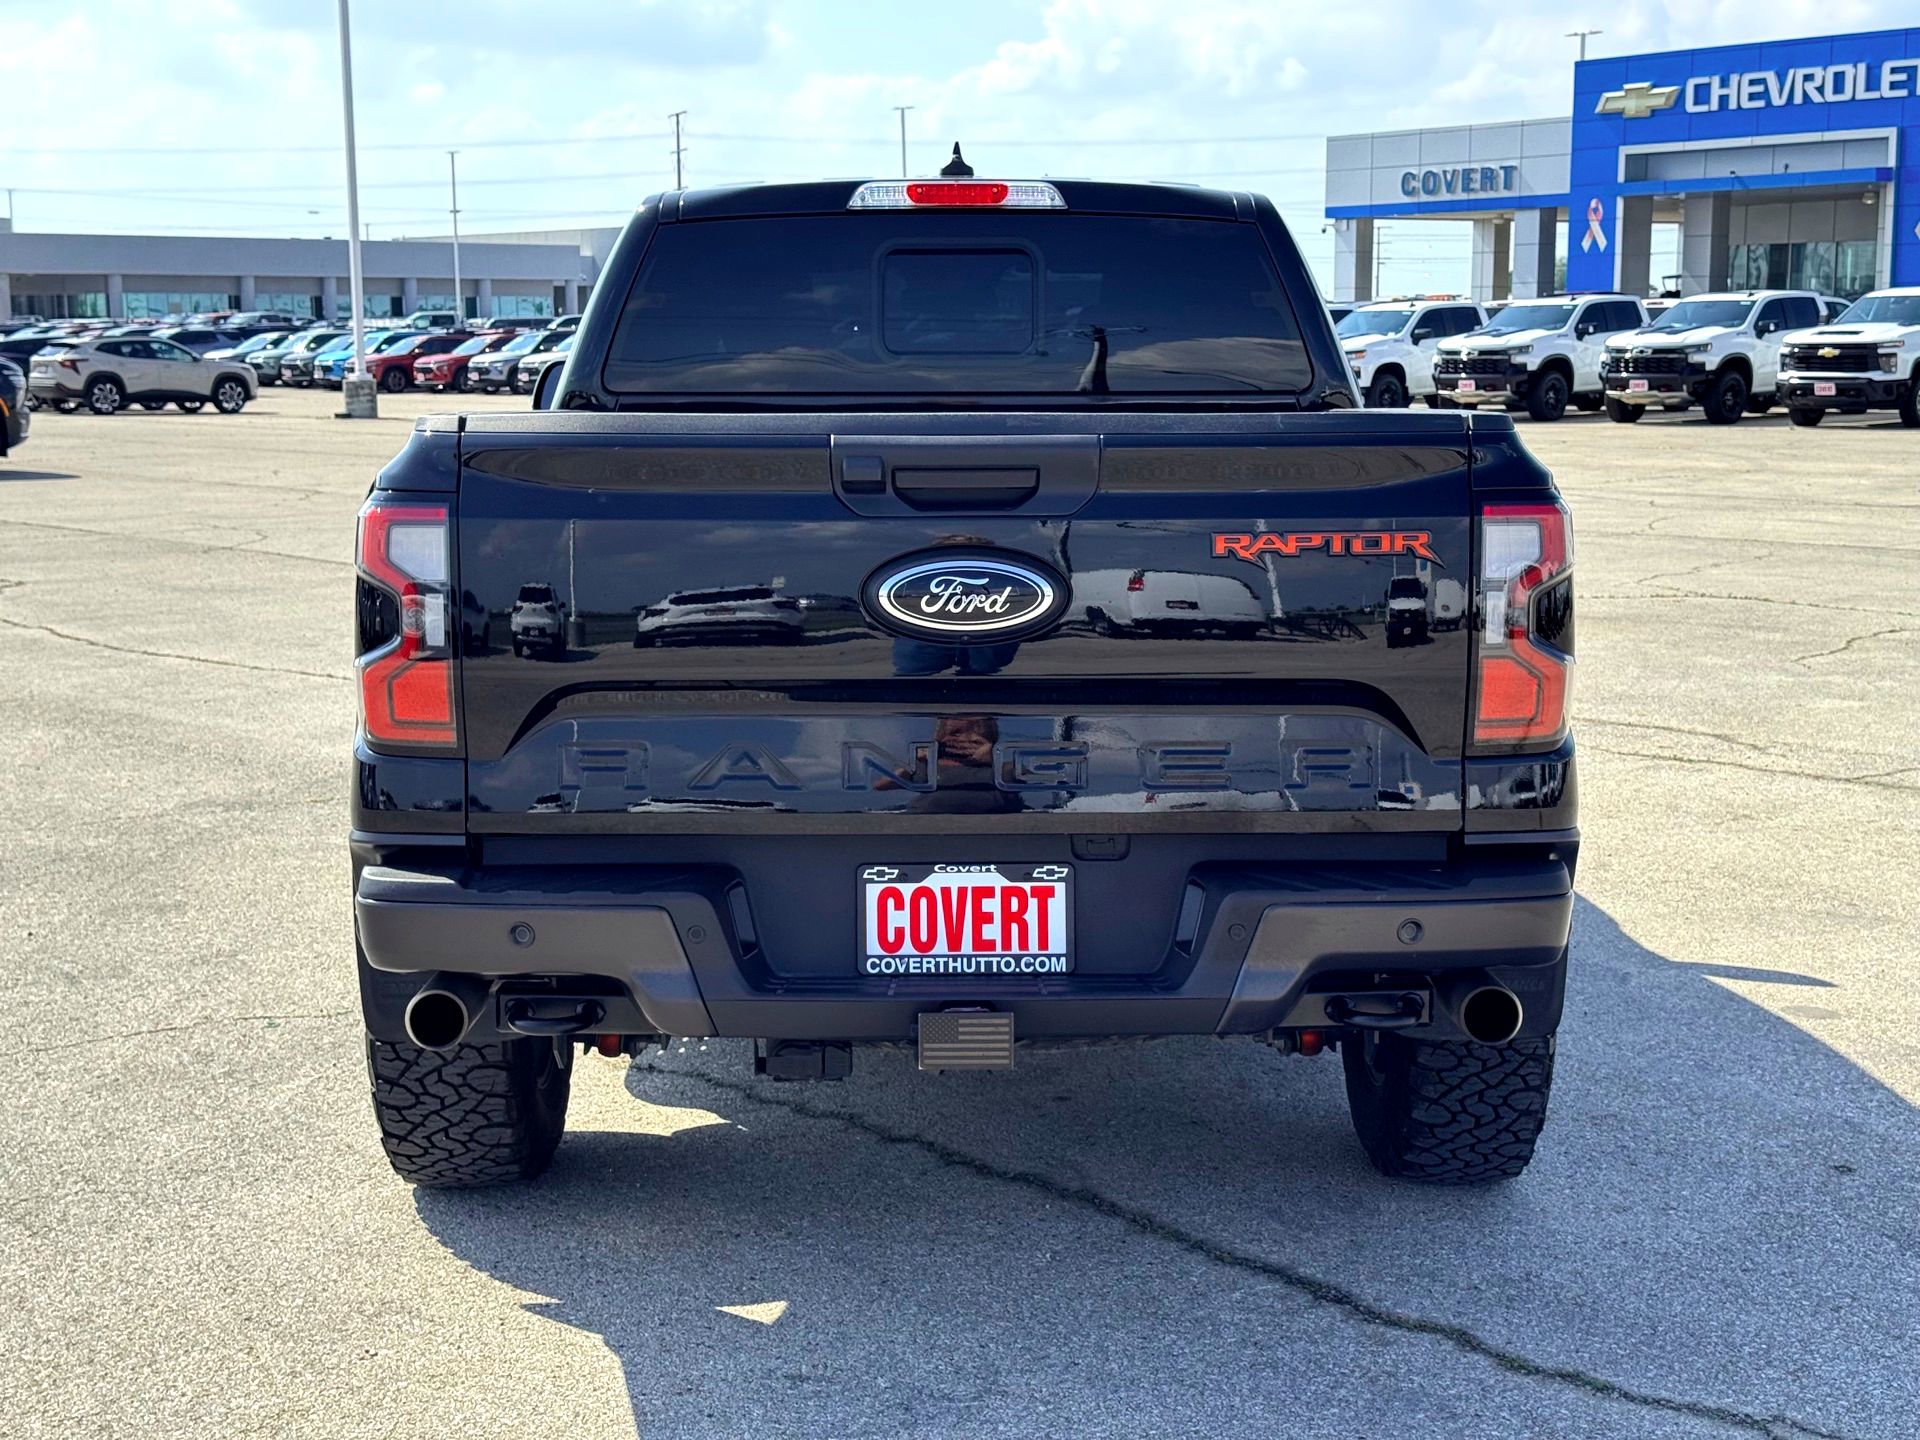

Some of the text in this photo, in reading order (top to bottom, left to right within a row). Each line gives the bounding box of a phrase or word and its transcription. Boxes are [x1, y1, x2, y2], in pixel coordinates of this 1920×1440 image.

[1401, 165, 1518, 197] COVERT
[1211, 532, 1446, 571] RAPTOR
[920, 576, 1012, 613] Ford
[557, 741, 1373, 791] RANGER
[934, 864, 997, 873] Covert
[877, 886, 1055, 954] COVERT
[866, 957, 1067, 973] COVERTHUTTO.COM
